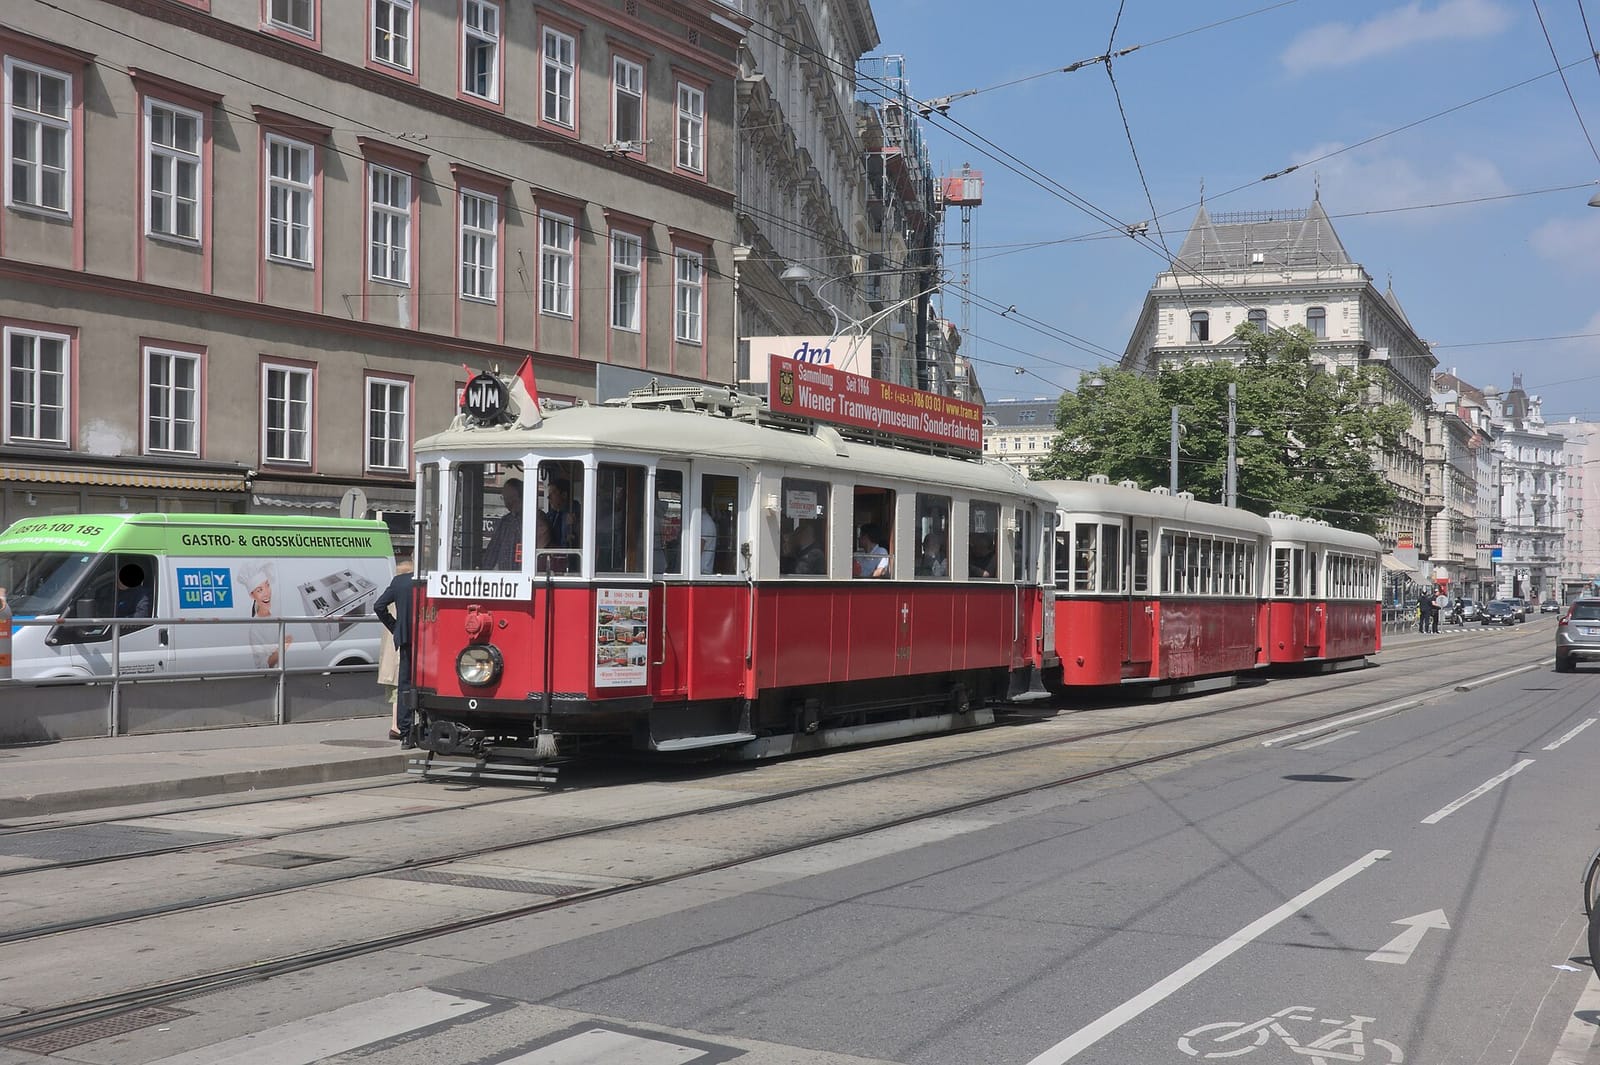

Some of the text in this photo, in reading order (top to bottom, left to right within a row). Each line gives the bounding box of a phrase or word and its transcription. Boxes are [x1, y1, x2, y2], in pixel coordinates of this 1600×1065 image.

[793, 342, 831, 364] dm
[798, 364, 834, 391] Sammlung
[846, 375, 857, 392] Seit
[857, 378, 870, 395] 1966
[798, 385, 979, 443] Wiener Tramwaymuseum/Sonderfahrten
[880, 384, 893, 401] Tel:
[945, 403, 979, 421] www.tram.at
[15, 523, 104, 536] 0810-100 185
[182, 533, 372, 548] GASTRO- & GROSSKÜCHENTECHNIK
[440, 574, 518, 598] Schottentor
